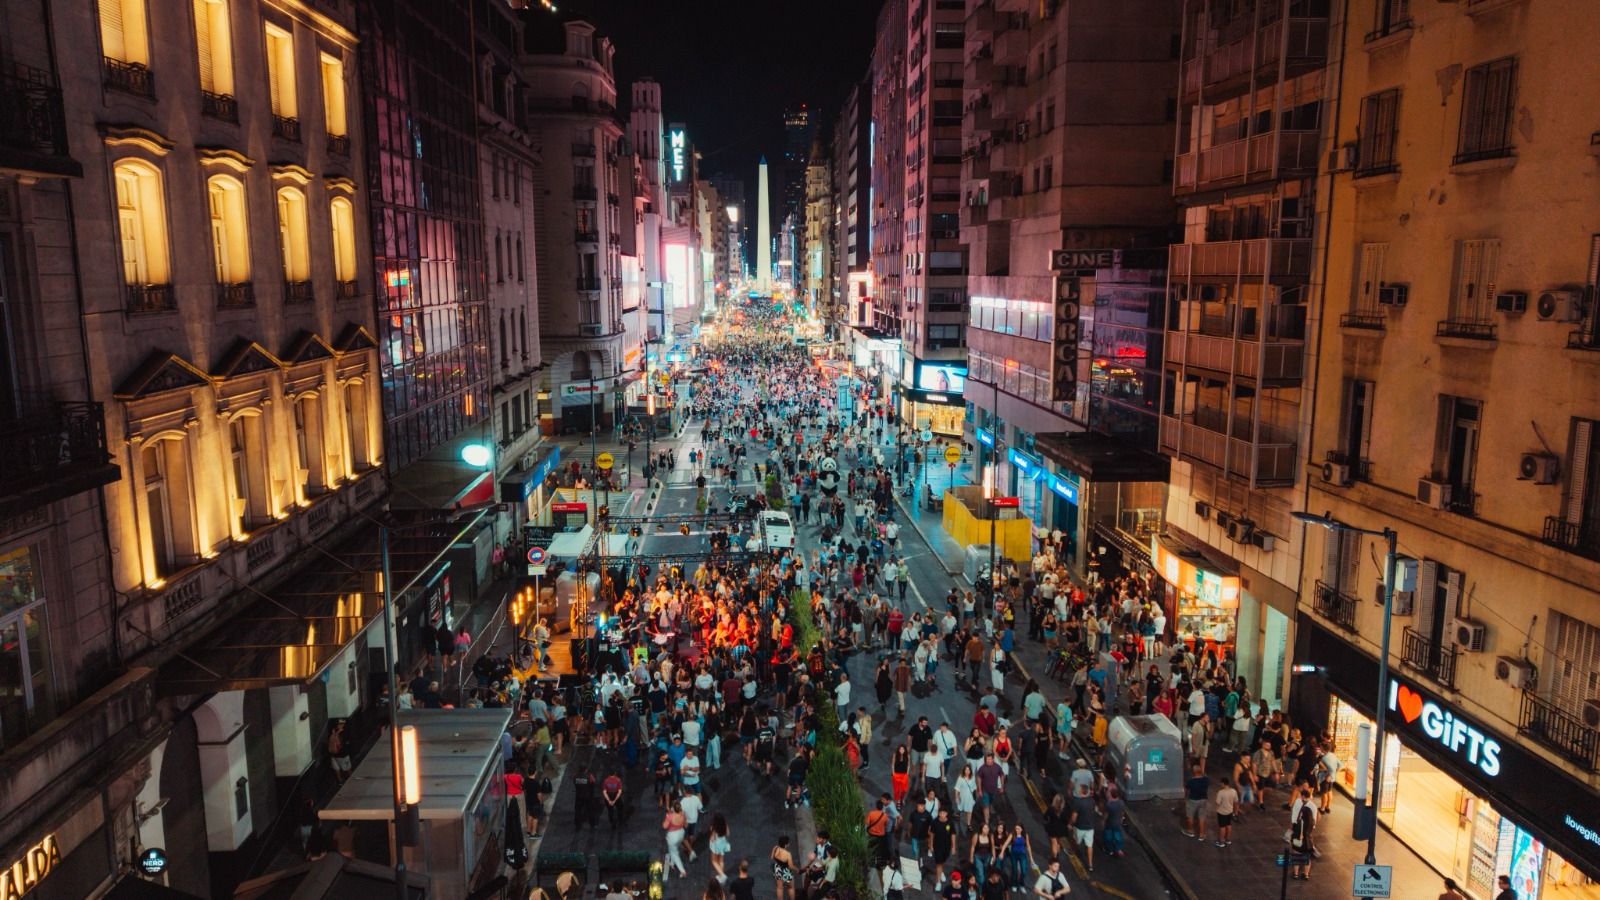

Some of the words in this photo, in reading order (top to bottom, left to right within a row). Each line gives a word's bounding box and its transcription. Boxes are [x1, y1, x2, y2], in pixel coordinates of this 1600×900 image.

[671, 130, 684, 181] MET
[1057, 253, 1110, 267] CINE
[1057, 281, 1079, 380] LORCA
[1389, 679, 1398, 711] I
[1421, 702, 1501, 776] GiFTS
[1144, 763, 1158, 771] BA
